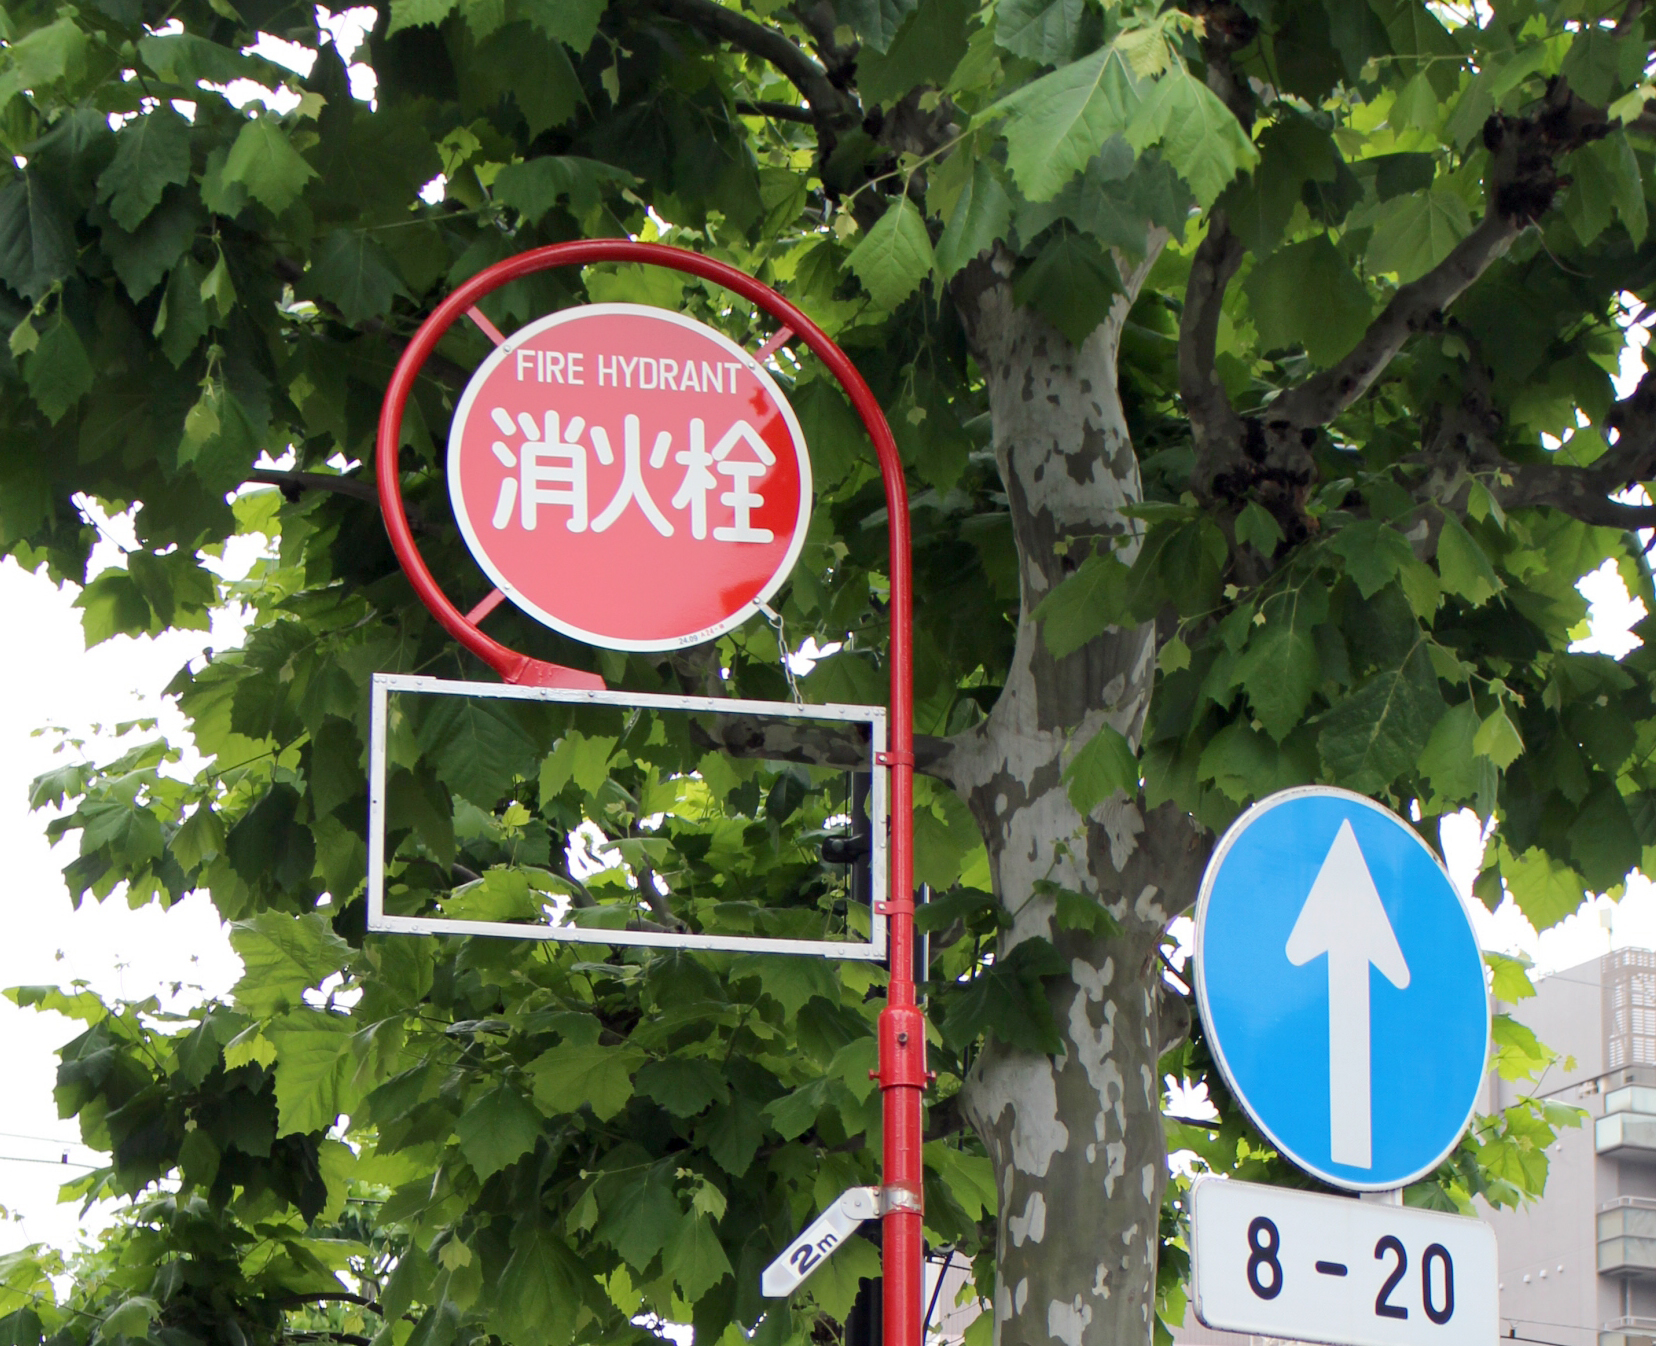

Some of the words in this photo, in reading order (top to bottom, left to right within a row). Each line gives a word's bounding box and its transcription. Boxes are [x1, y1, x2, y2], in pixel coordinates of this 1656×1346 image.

[516, 348, 584, 386] FIRE
[598, 354, 743, 394] HYDRANT
[491, 407, 777, 544] 消火栓
[789, 1232, 839, 1276] 2m
